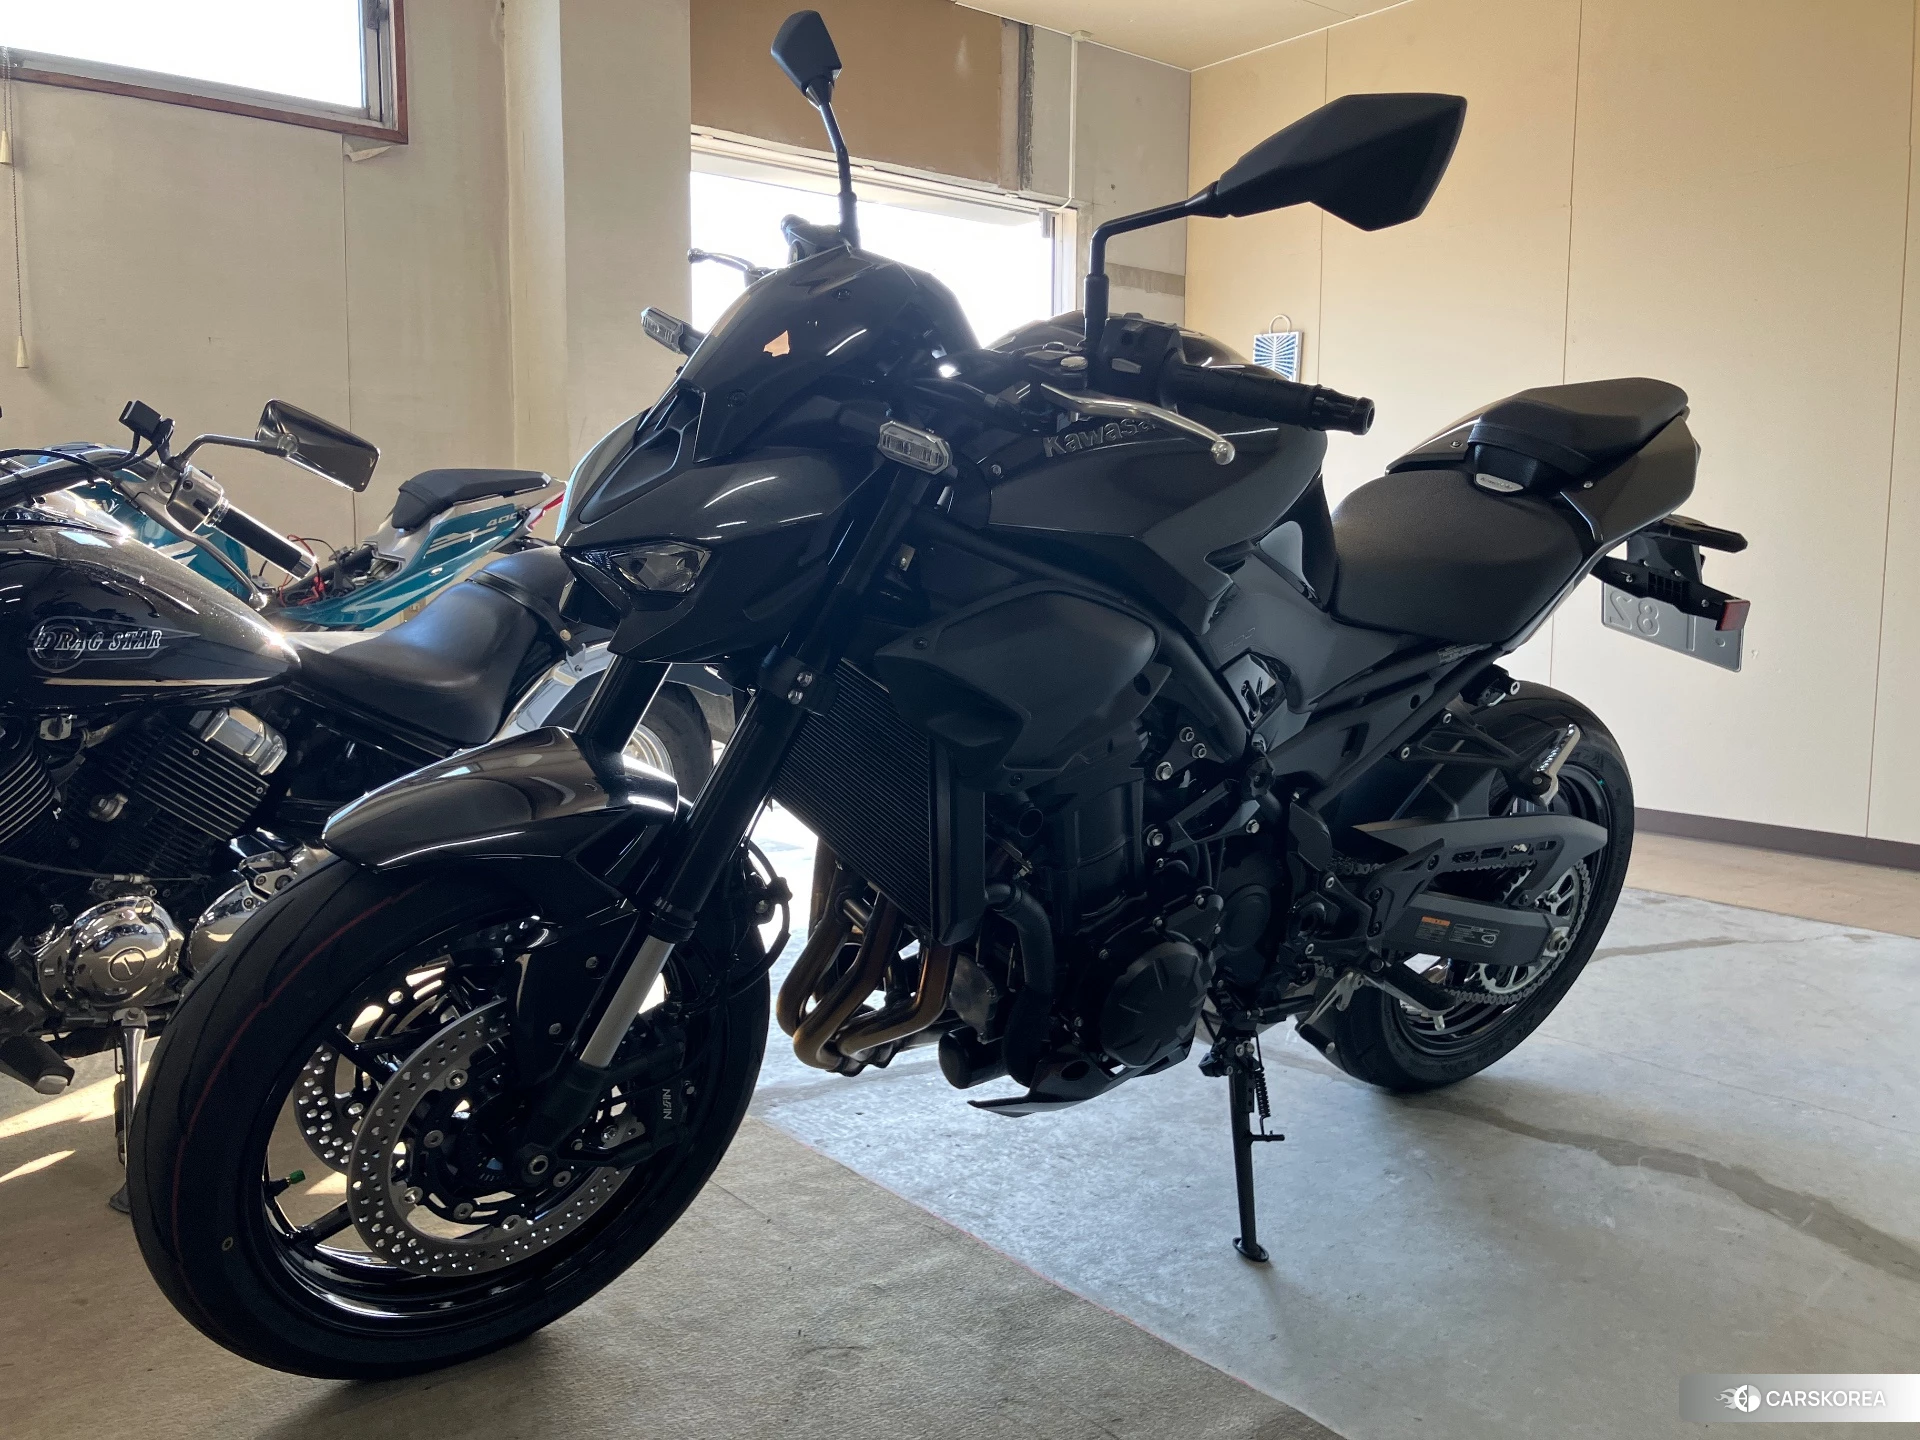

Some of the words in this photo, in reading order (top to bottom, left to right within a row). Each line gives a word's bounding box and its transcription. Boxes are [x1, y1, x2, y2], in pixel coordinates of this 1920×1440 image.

[1043, 418, 1156, 458] Kawasa
[34, 625, 104, 651] DRAG
[108, 629, 163, 651] STAR
